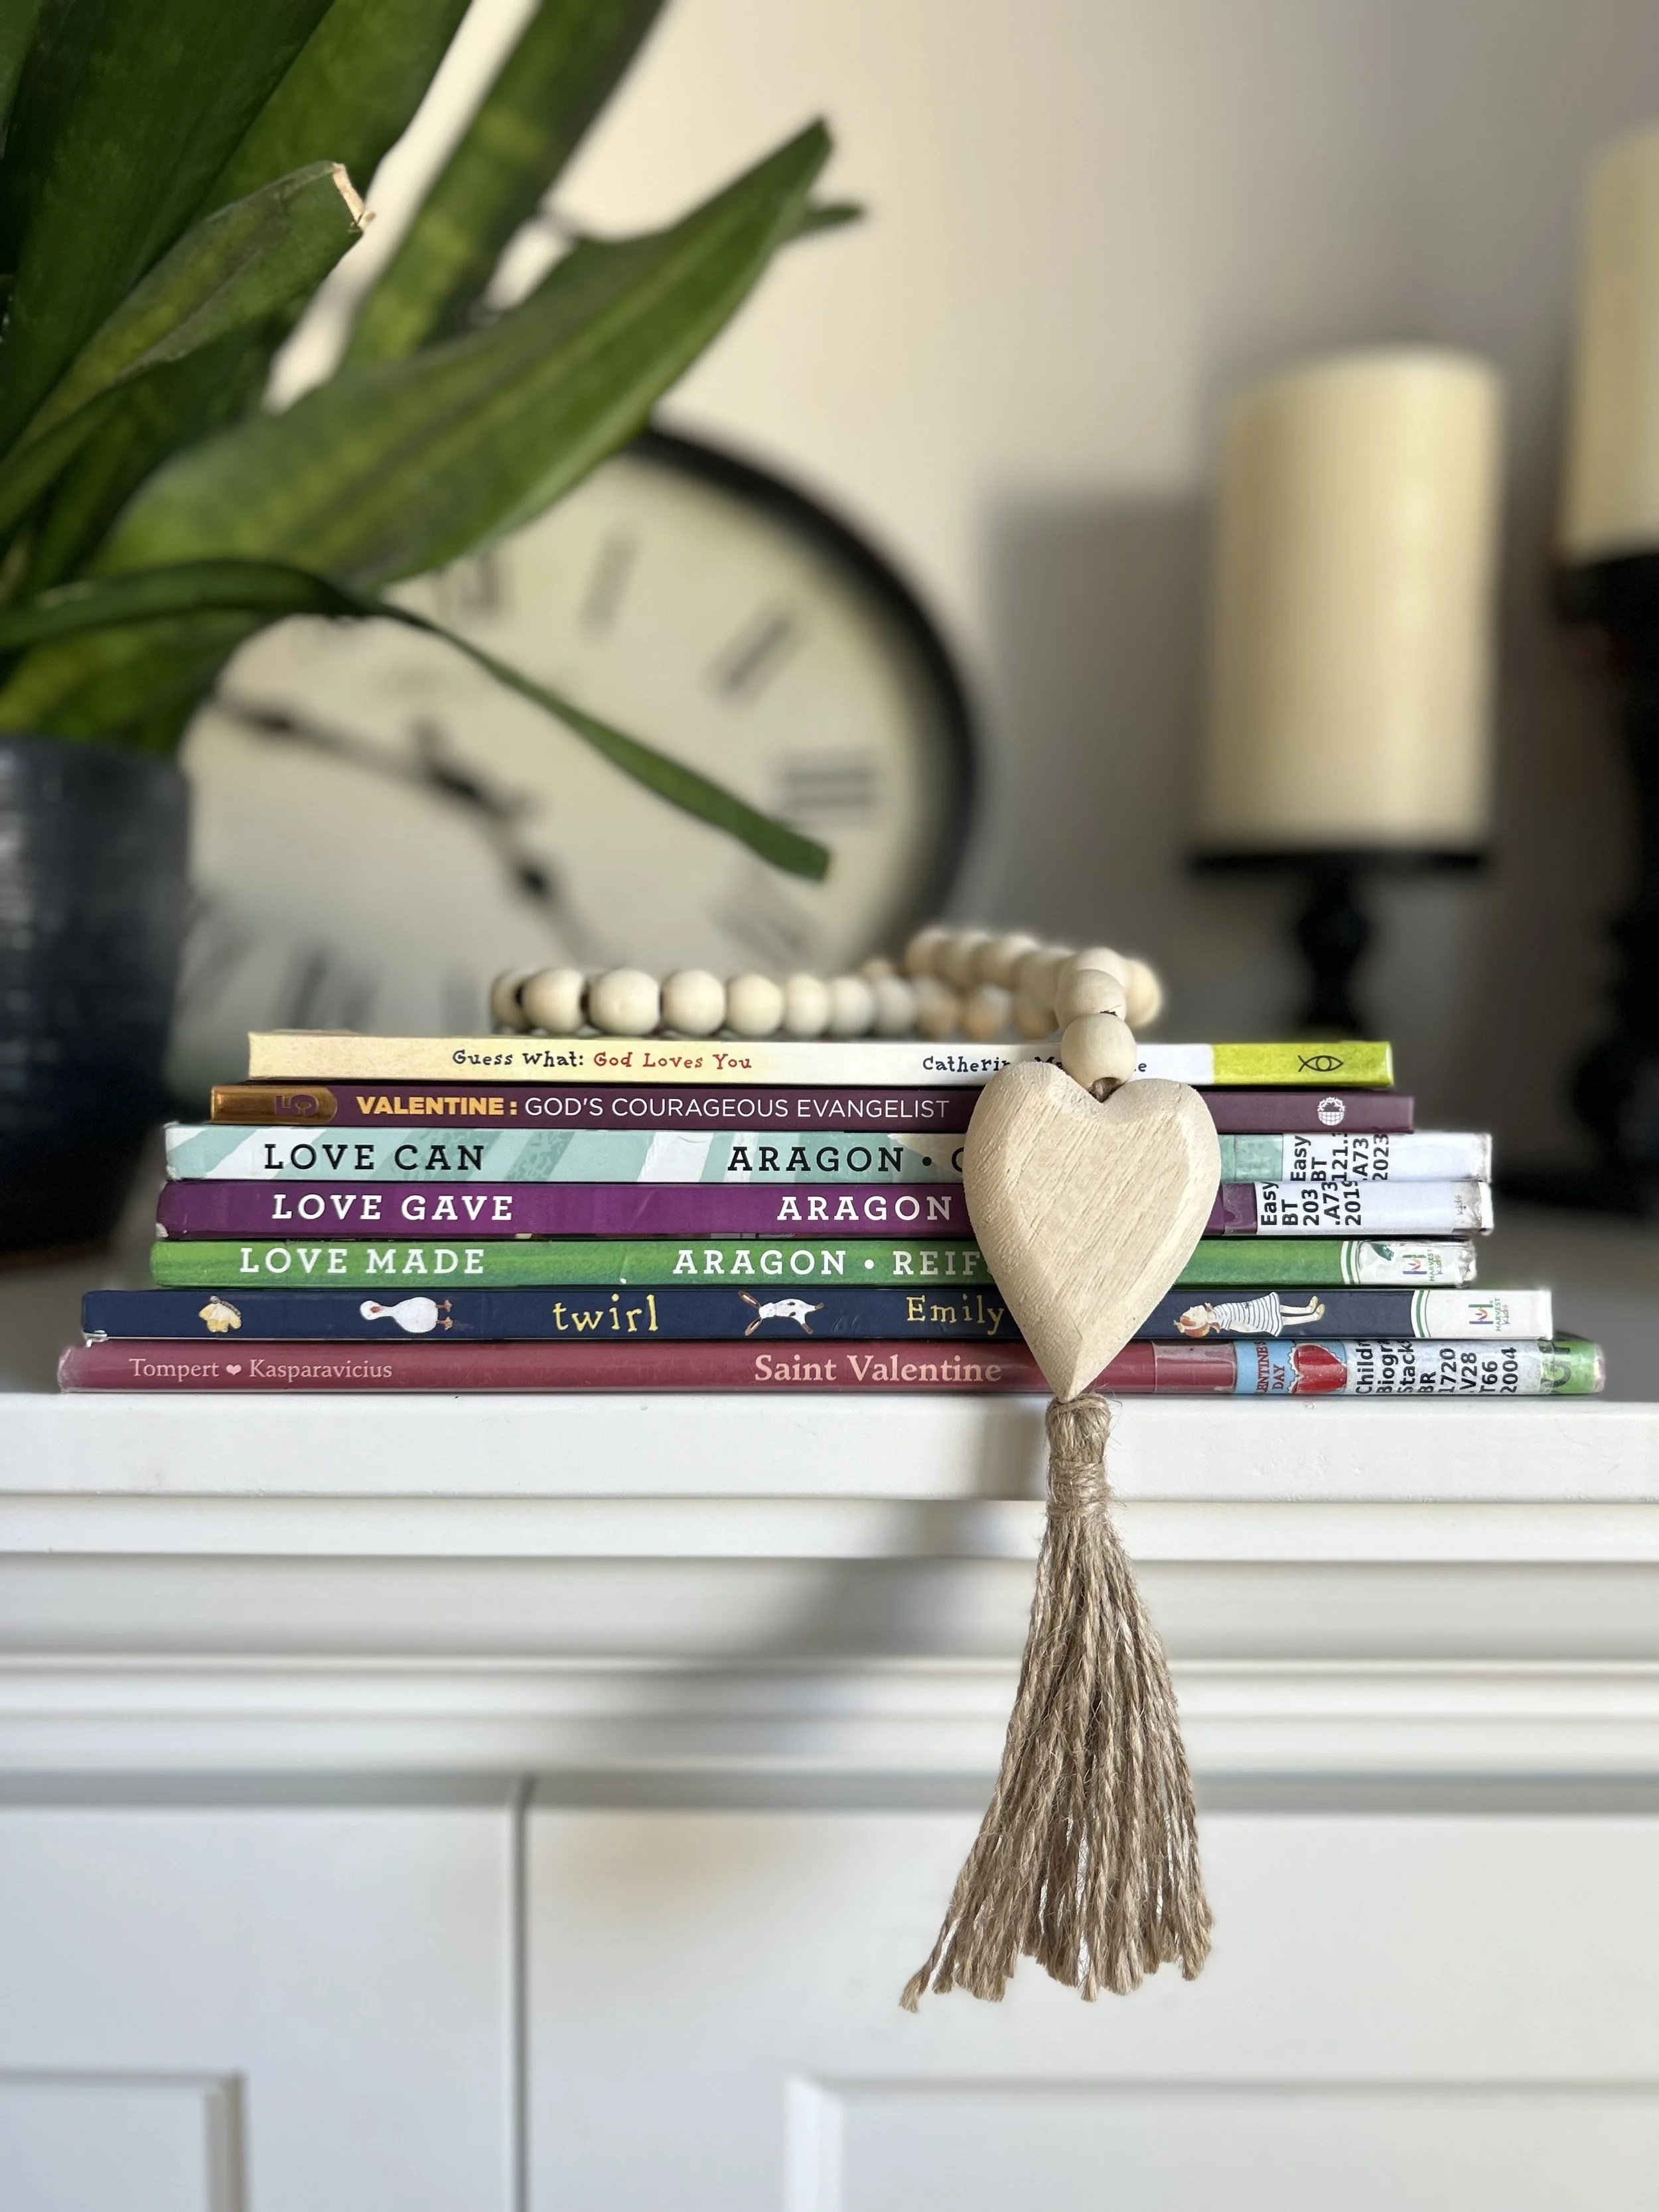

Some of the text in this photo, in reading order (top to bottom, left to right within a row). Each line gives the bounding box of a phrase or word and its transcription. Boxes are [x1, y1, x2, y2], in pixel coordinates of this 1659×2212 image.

[452, 1049, 752, 1070] Guess What: God Loves You
[922, 1056, 1011, 1072] Catheri
[356, 1096, 950, 1118] VALENTINE: GOD'S COURAGEOUS EVANGELIST
[265, 1143, 484, 1171] LOVE CAN
[727, 1146, 904, 1172] ARAGON
[1290, 1136, 1311, 1181] Easy
[1310, 1157, 1327, 1181] BT
[1372, 1134, 1389, 1181] 2023
[272, 1194, 512, 1220] LOVE GAVE
[776, 1195, 952, 1221] ARAGON
[1260, 1181, 1279, 1226] Easy
[1281, 1199, 1299, 1226] BT
[1301, 1189, 1320, 1226] 203
[1321, 1181, 1340, 1225] .A73
[240, 1247, 484, 1274] LOVE MADE
[672, 1250, 846, 1275] ARAGON
[552, 1293, 659, 1332] twirl
[906, 1295, 1005, 1335] Emily
[1500, 1304, 1510, 1325] Kids
[129, 1358, 392, 1381] Tompert Kasparavicius
[755, 1354, 1002, 1382] Saint Valentine
[1272, 1364, 1285, 1390] DAY
[1355, 1339, 1374, 1394] Childr
[1438, 1348, 1457, 1393] 1720
[1500, 1347, 1518, 1393] 2004
[1417, 1371, 1437, 1393] BR
